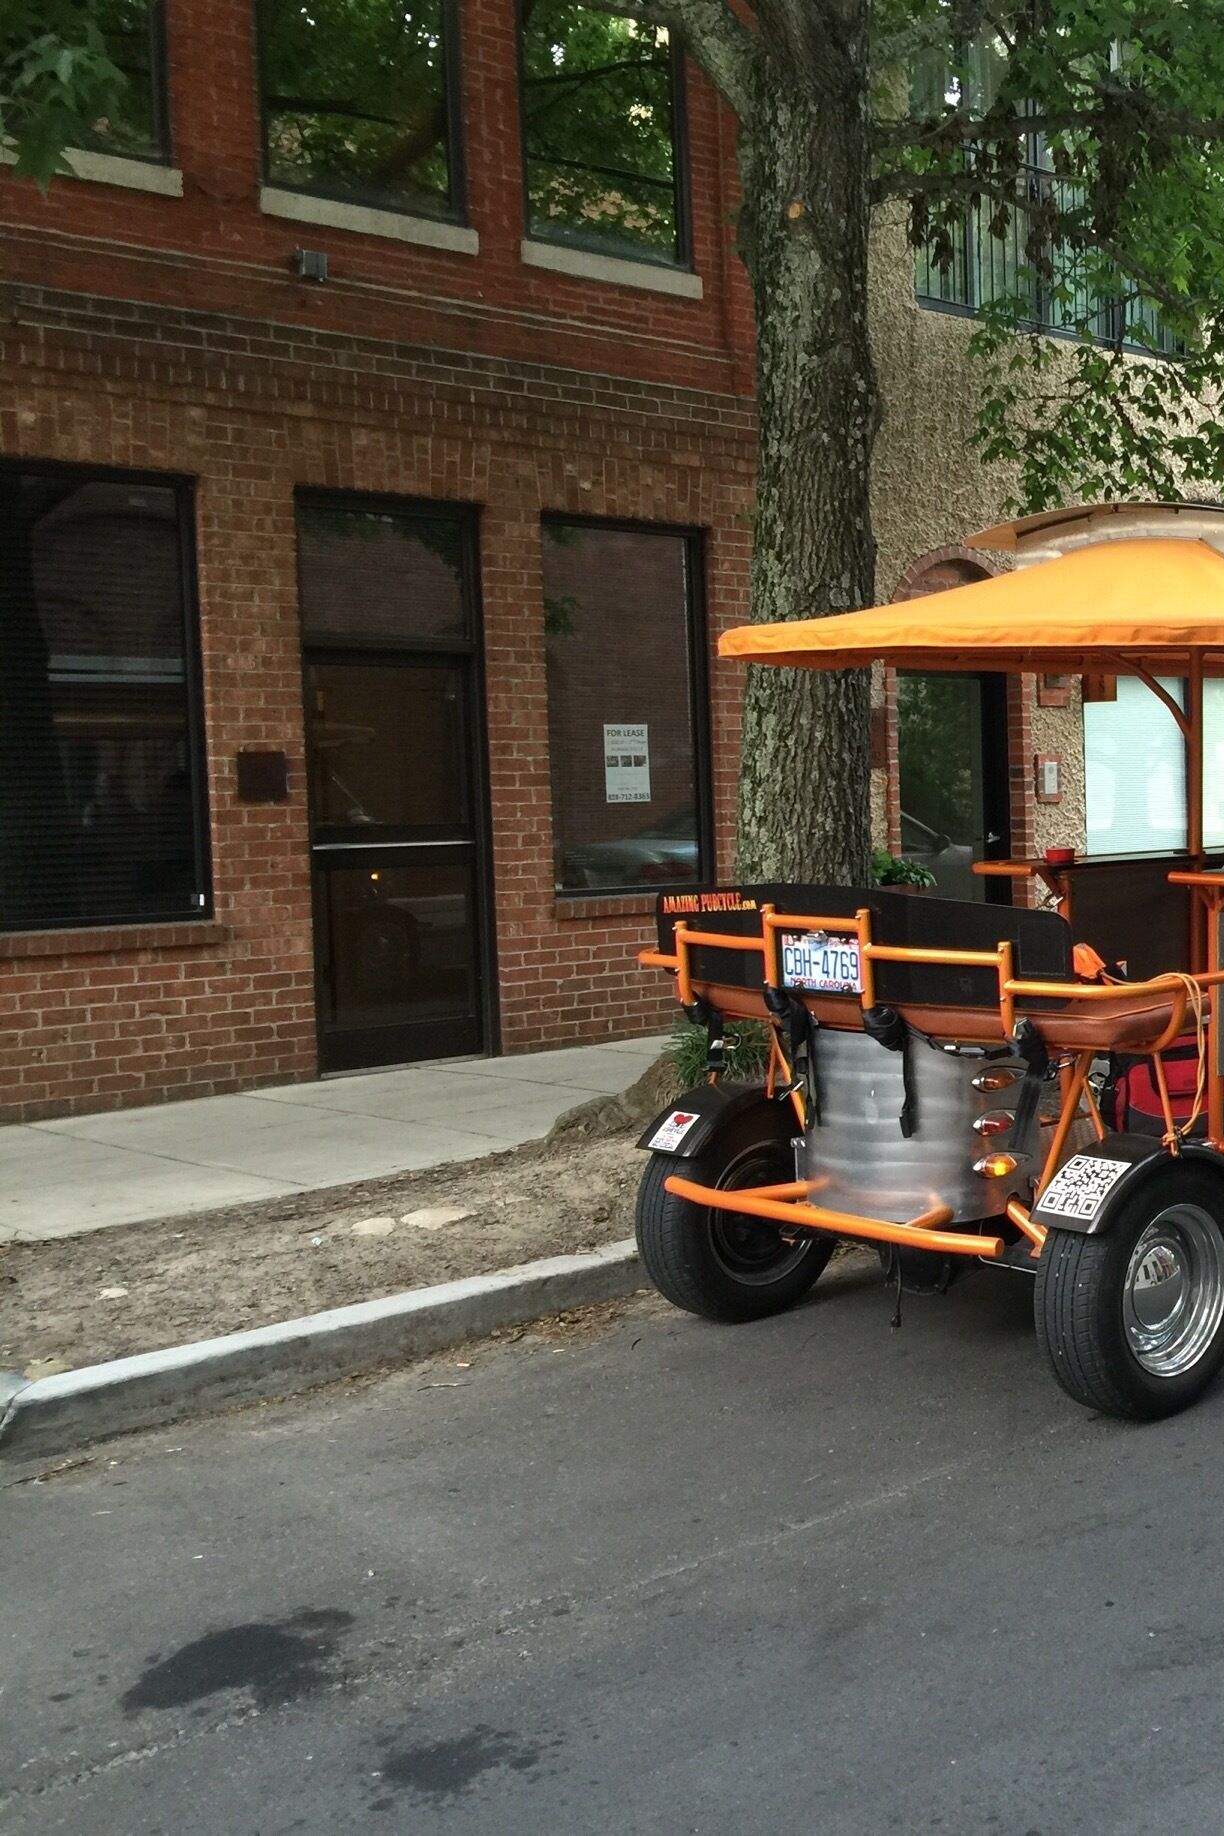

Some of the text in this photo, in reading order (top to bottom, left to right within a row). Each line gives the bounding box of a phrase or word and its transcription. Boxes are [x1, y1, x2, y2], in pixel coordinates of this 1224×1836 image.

[606, 729, 645, 737] FOR LEASE
[664, 895, 700, 913] AMAZING
[785, 947, 859, 980] CBH-4769
